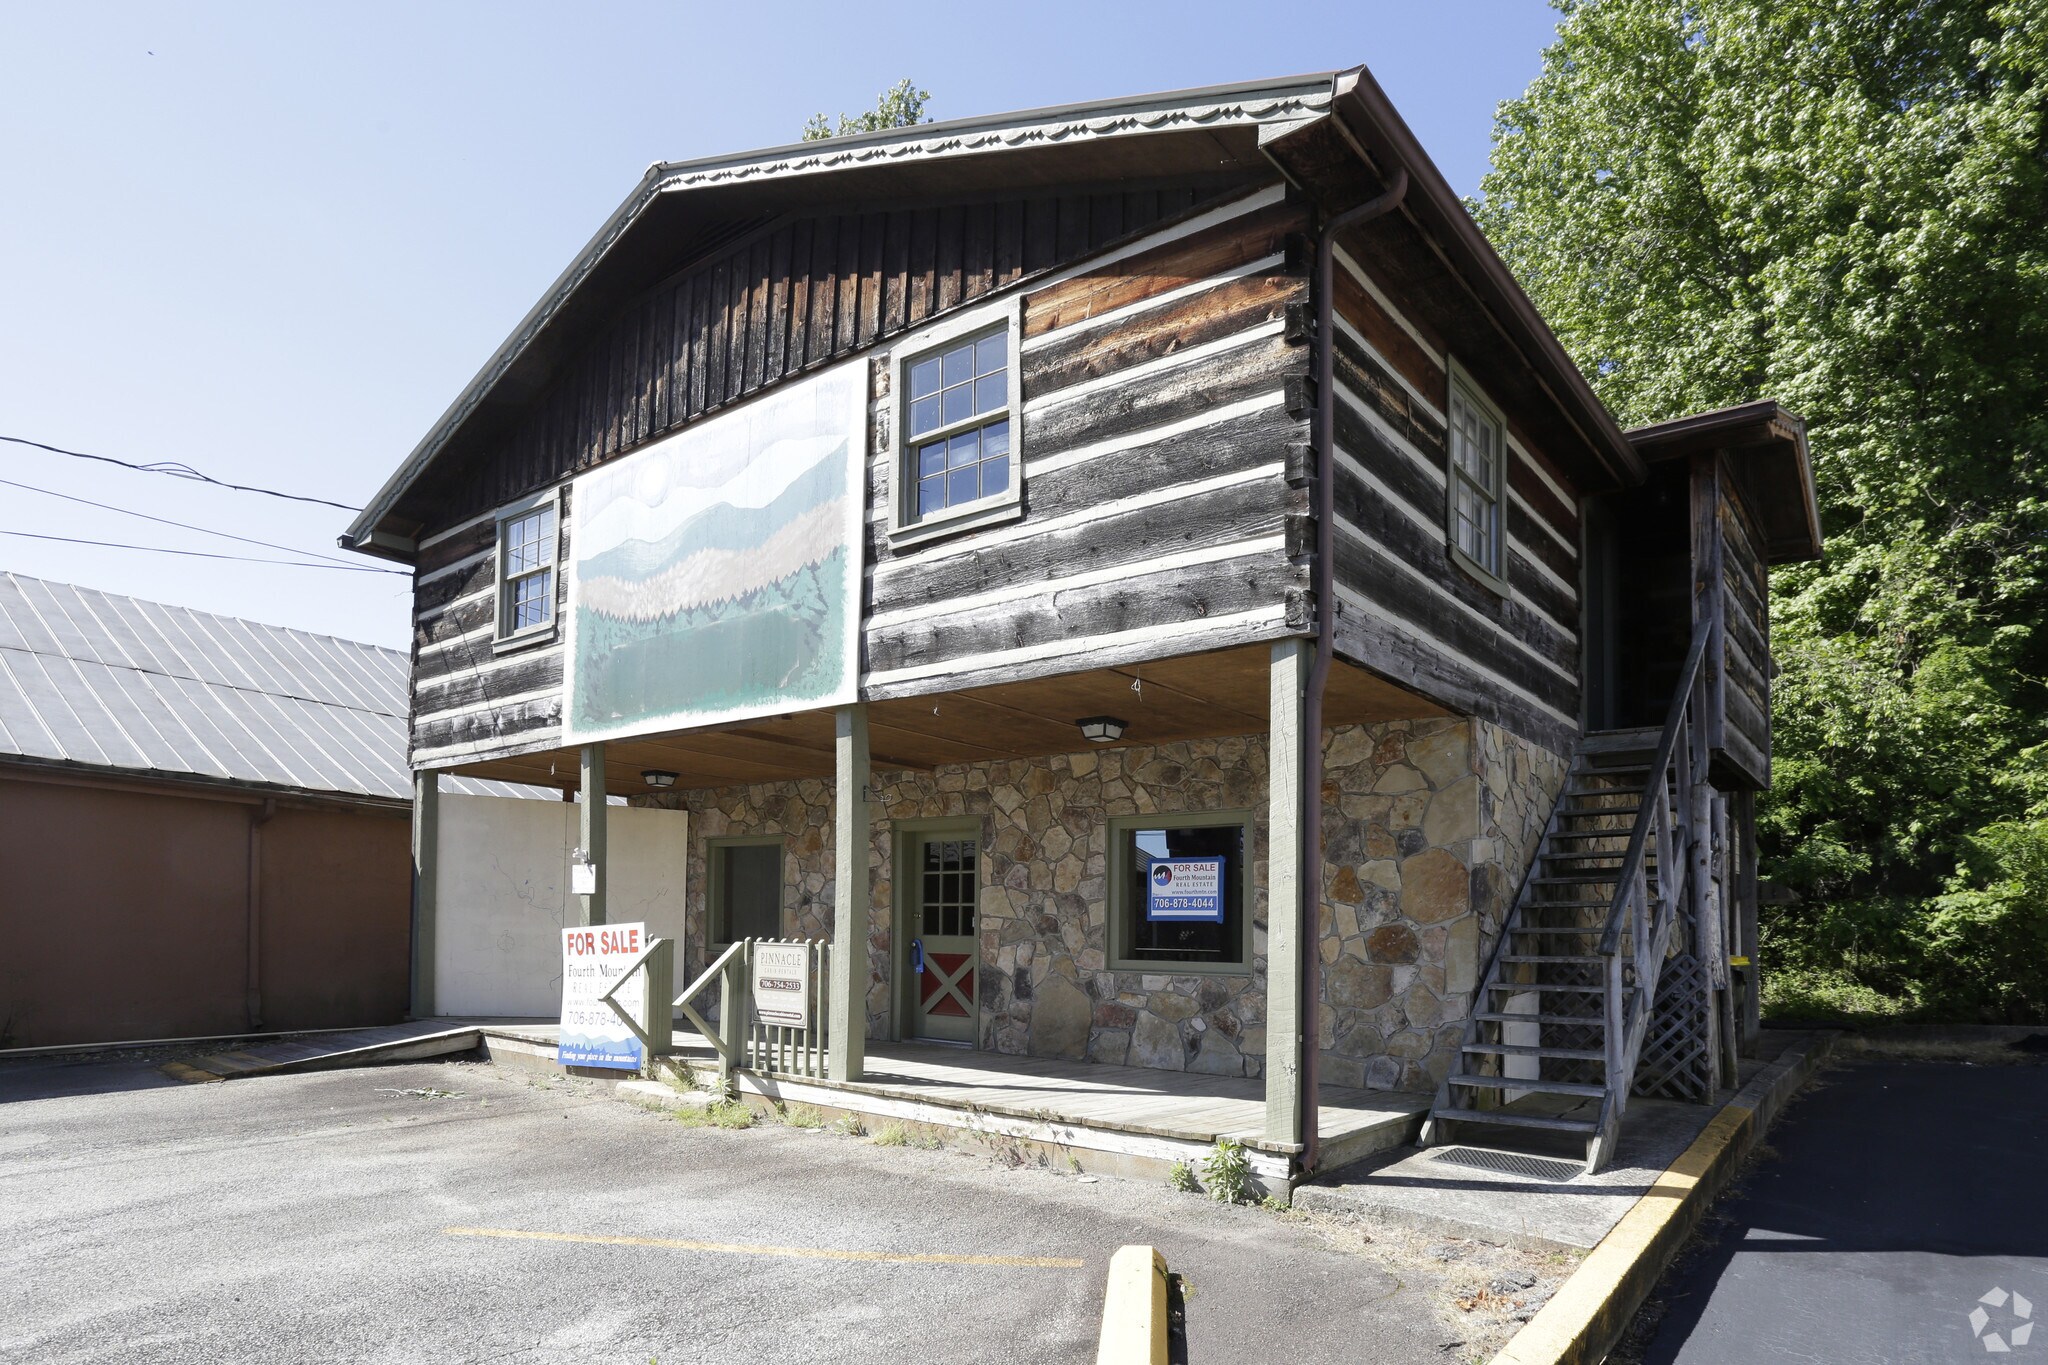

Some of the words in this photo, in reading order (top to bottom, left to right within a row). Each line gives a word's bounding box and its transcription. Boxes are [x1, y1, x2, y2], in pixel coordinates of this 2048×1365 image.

[1173, 864, 1190, 872] FOR
[1193, 864, 1216, 872] SALE
[1154, 898, 1214, 908] 706-878-4044
[567, 932, 595, 956] FOR
[601, 929, 639, 955] SALE
[760, 952, 801, 966] PINNACLE
[568, 964, 595, 977] Fourth
[761, 980, 800, 990] 706-754-2533
[562, 1051, 577, 1061] Finding
[576, 1053, 586, 1061] your
[586, 1052, 598, 1062] place
[598, 1052, 605, 1061] in
[604, 1053, 613, 1061] the
[613, 1053, 638, 1063] mountains
